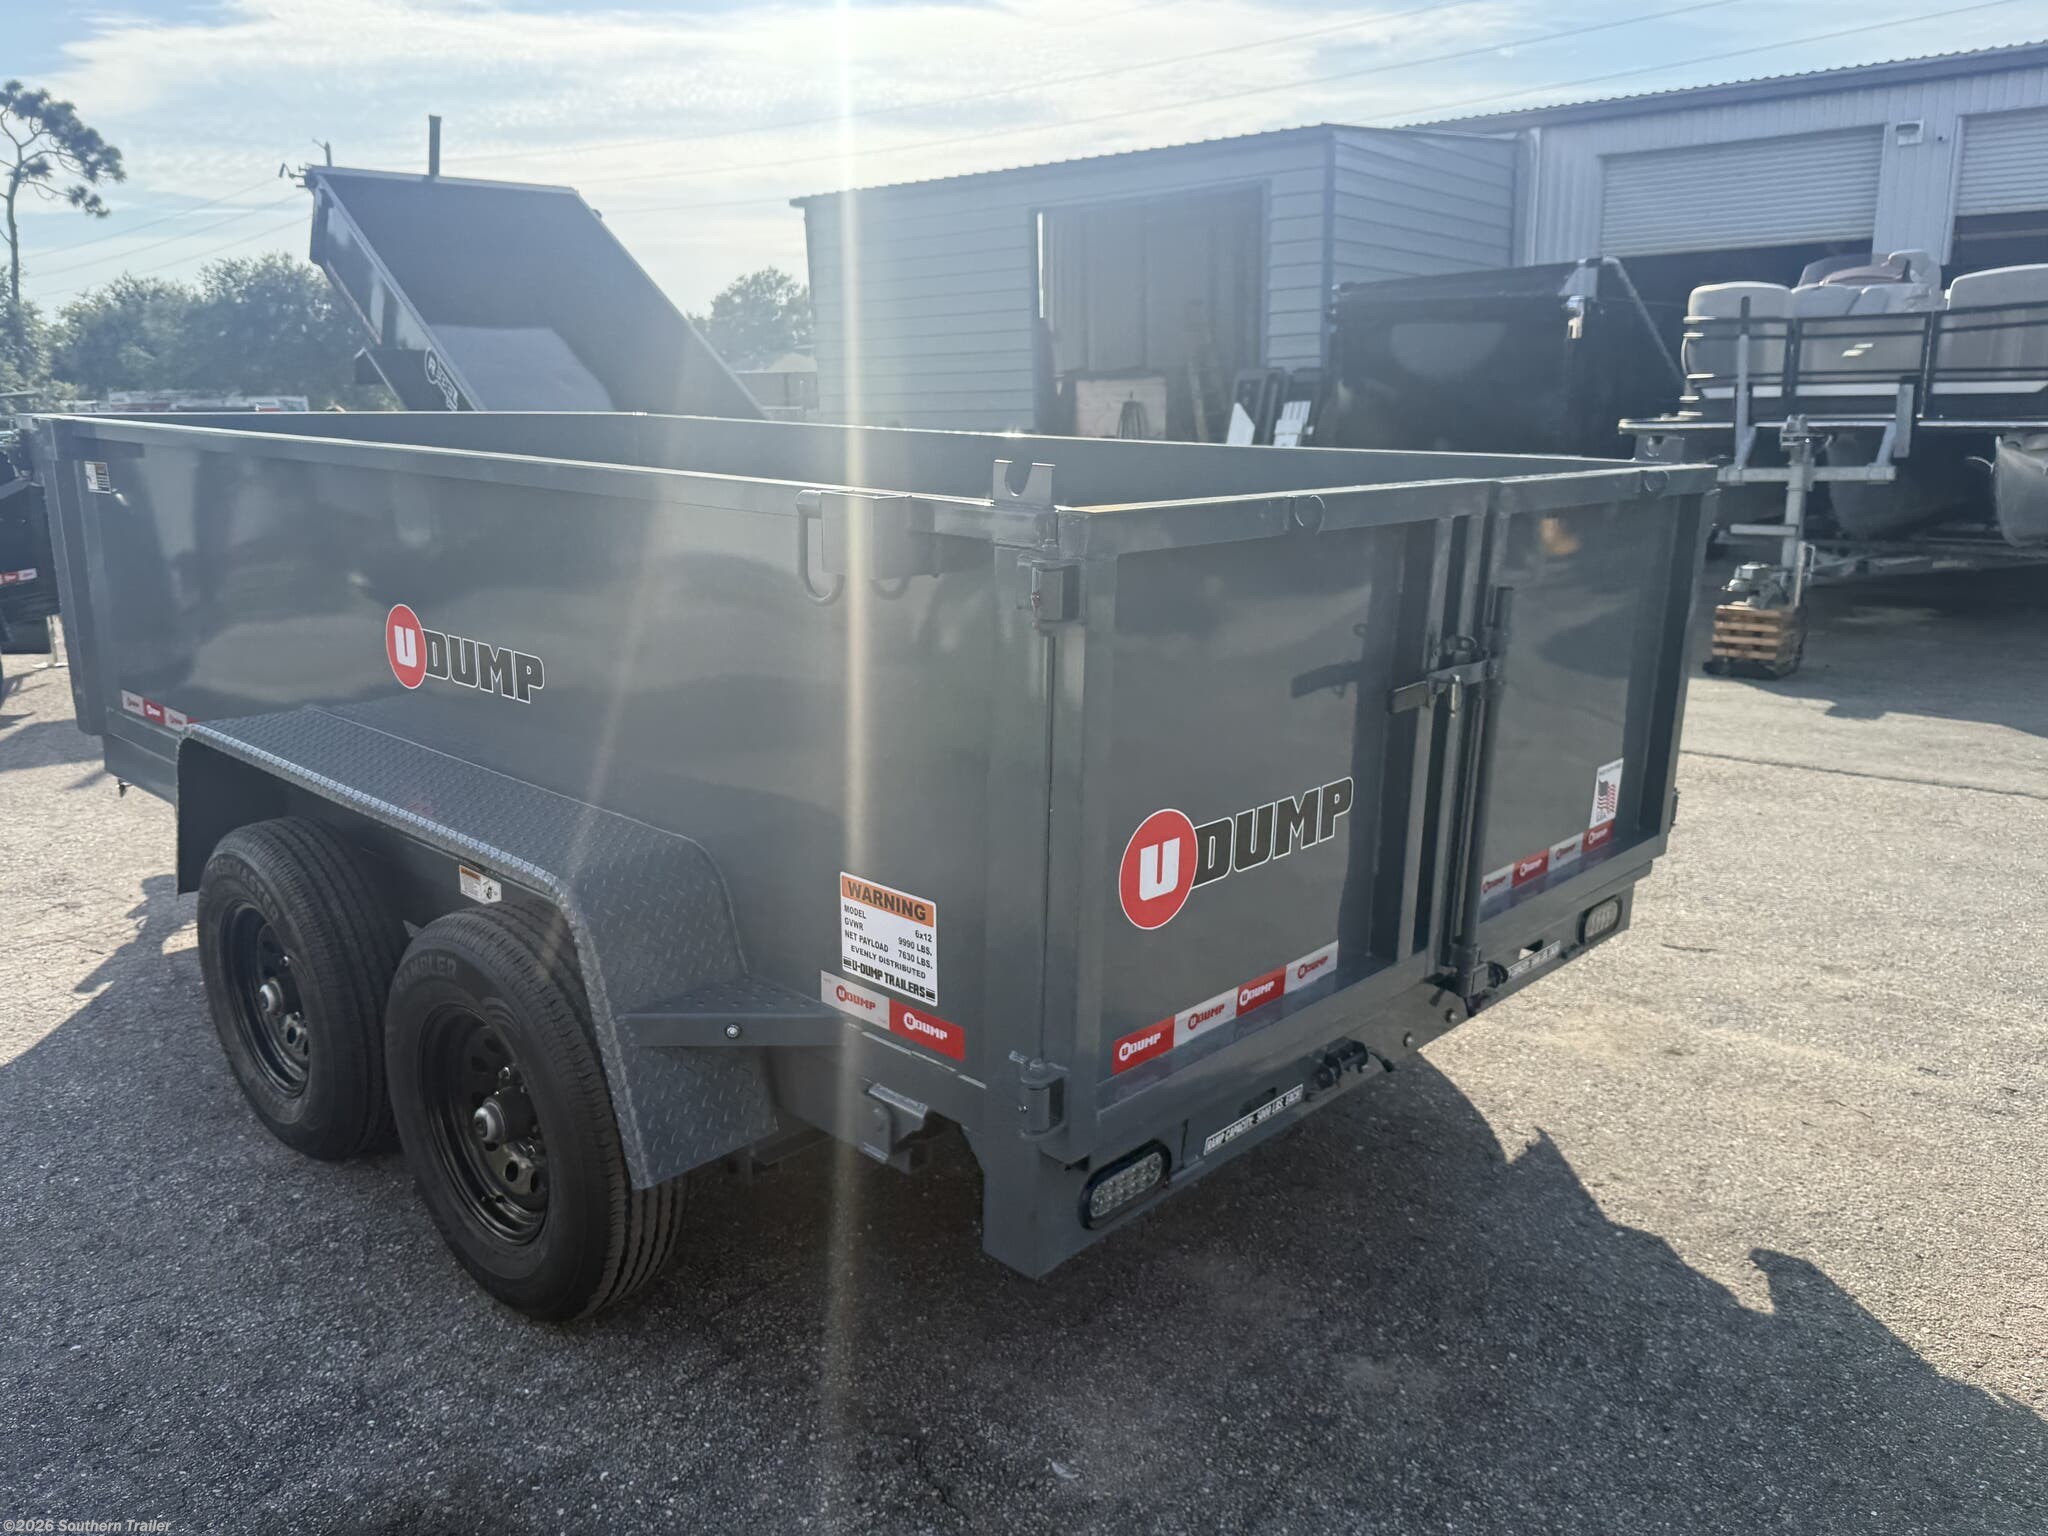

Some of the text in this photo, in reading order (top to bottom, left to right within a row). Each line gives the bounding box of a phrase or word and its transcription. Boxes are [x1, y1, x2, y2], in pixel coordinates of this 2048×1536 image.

[847, 880, 927, 921] WARNING
[844, 903, 933, 943] MODEL 6x12
[844, 917, 933, 957] GVWR 9990 LBS.
[844, 929, 934, 970] NET PAYLOAD 7630 LBS.
[850, 945, 926, 980] EVENLY DISTRIBUTED
[852, 959, 926, 998] U-DUMP TRAILERS
